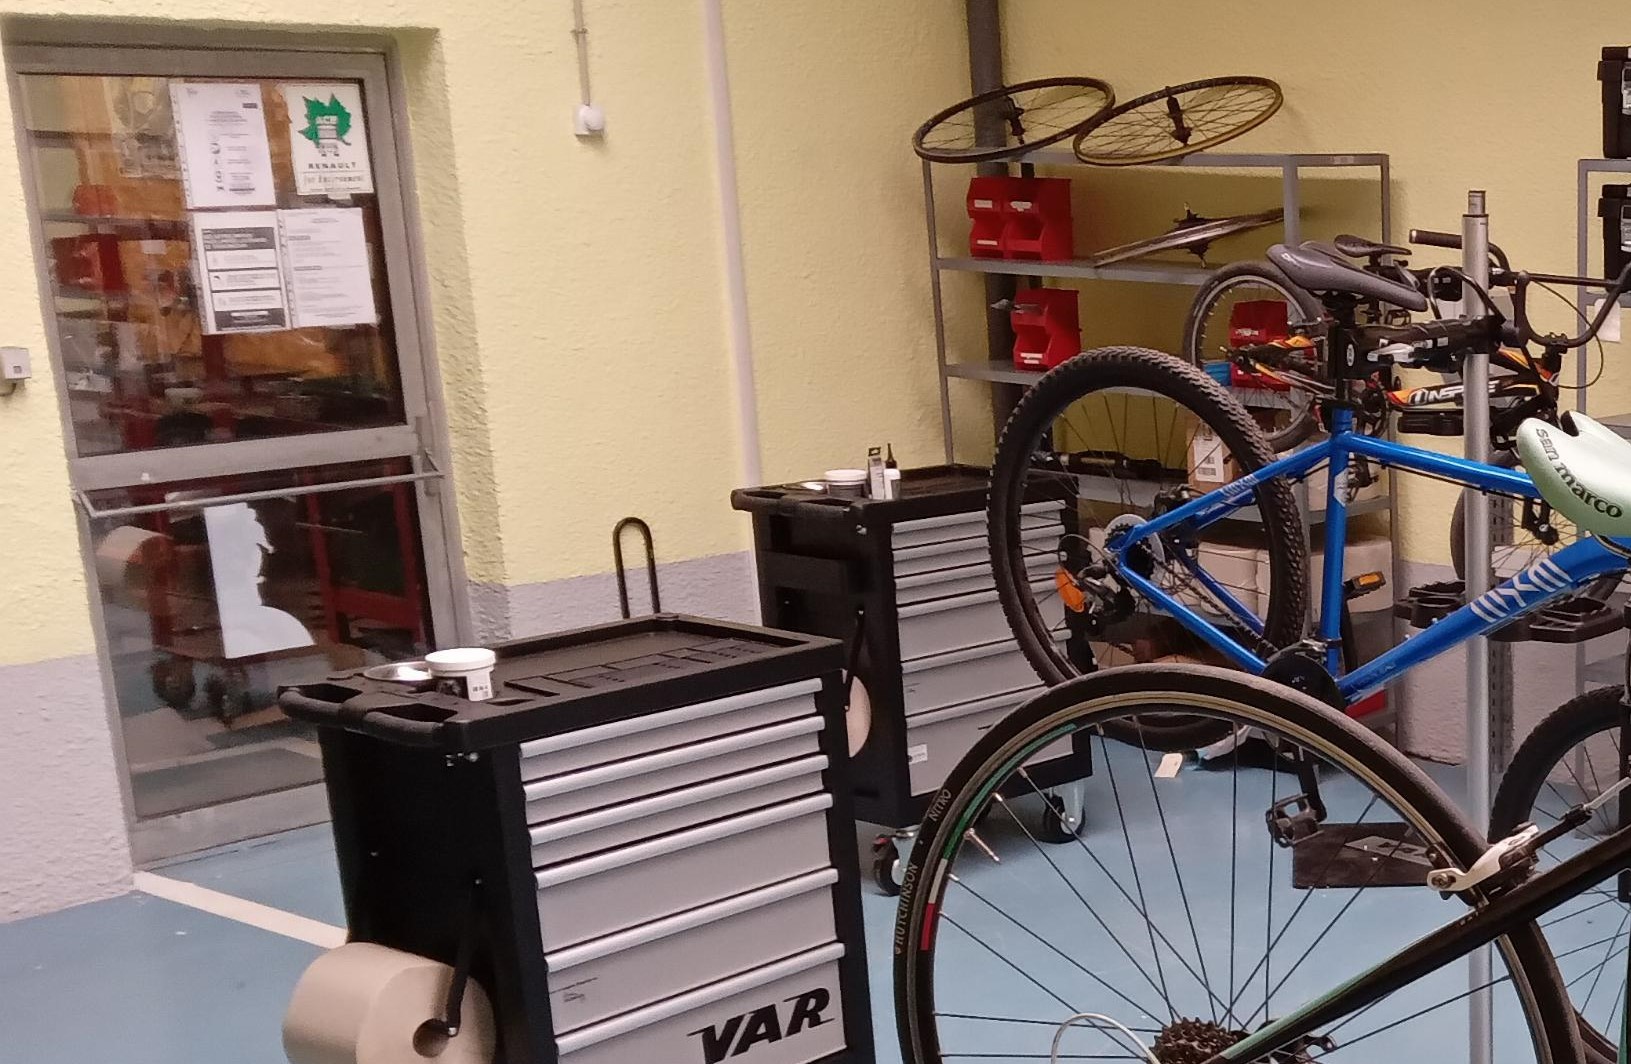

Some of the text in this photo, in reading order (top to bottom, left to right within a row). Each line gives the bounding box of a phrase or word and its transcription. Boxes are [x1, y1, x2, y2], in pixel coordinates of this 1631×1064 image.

[1534, 427, 1623, 518] san marco
[928, 788, 952, 822] NITRO
[895, 863, 919, 948] HUTCHINSON
